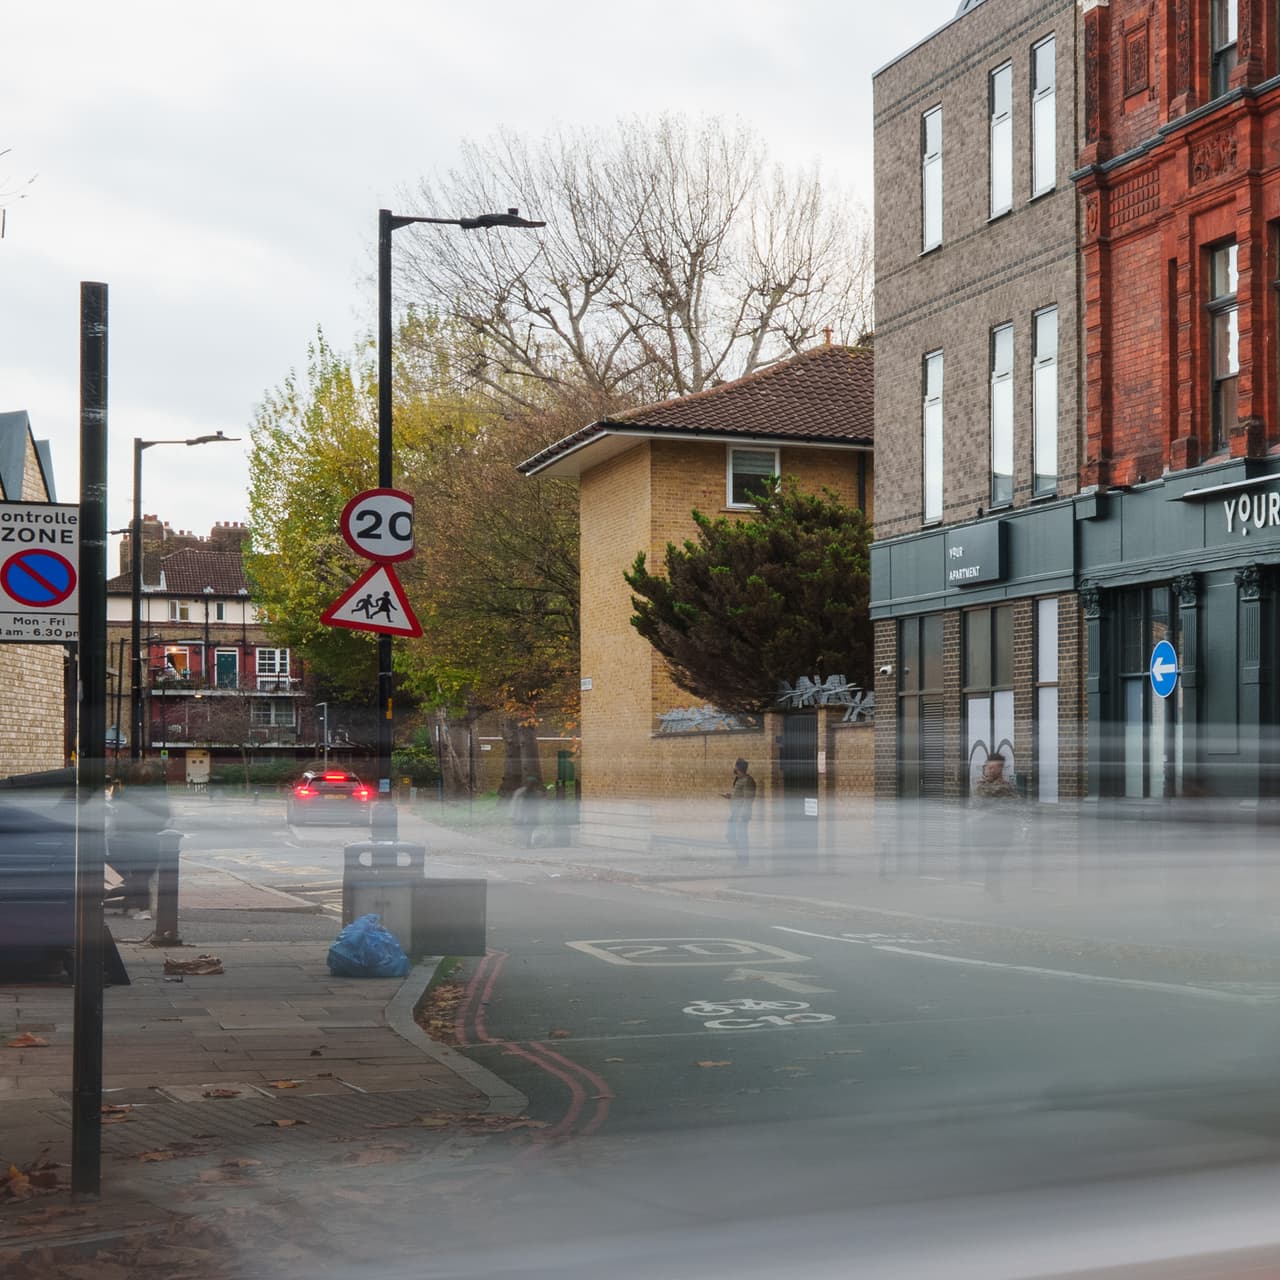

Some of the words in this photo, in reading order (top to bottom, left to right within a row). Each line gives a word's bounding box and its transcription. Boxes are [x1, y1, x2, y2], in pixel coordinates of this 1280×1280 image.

[1, 511, 78, 524] ontrolle
[1224, 492, 1280, 536] YOUR
[356, 510, 413, 541] 20
[2, 527, 74, 544] ZONE
[949, 566, 980, 580] APARTMENT
[13, 617, 39, 626] Mon
[49, 618, 65, 626] Fri
[5, 628, 24, 637] am
[33, 628, 63, 638] 6.30
[607, 943, 759, 957] 20
